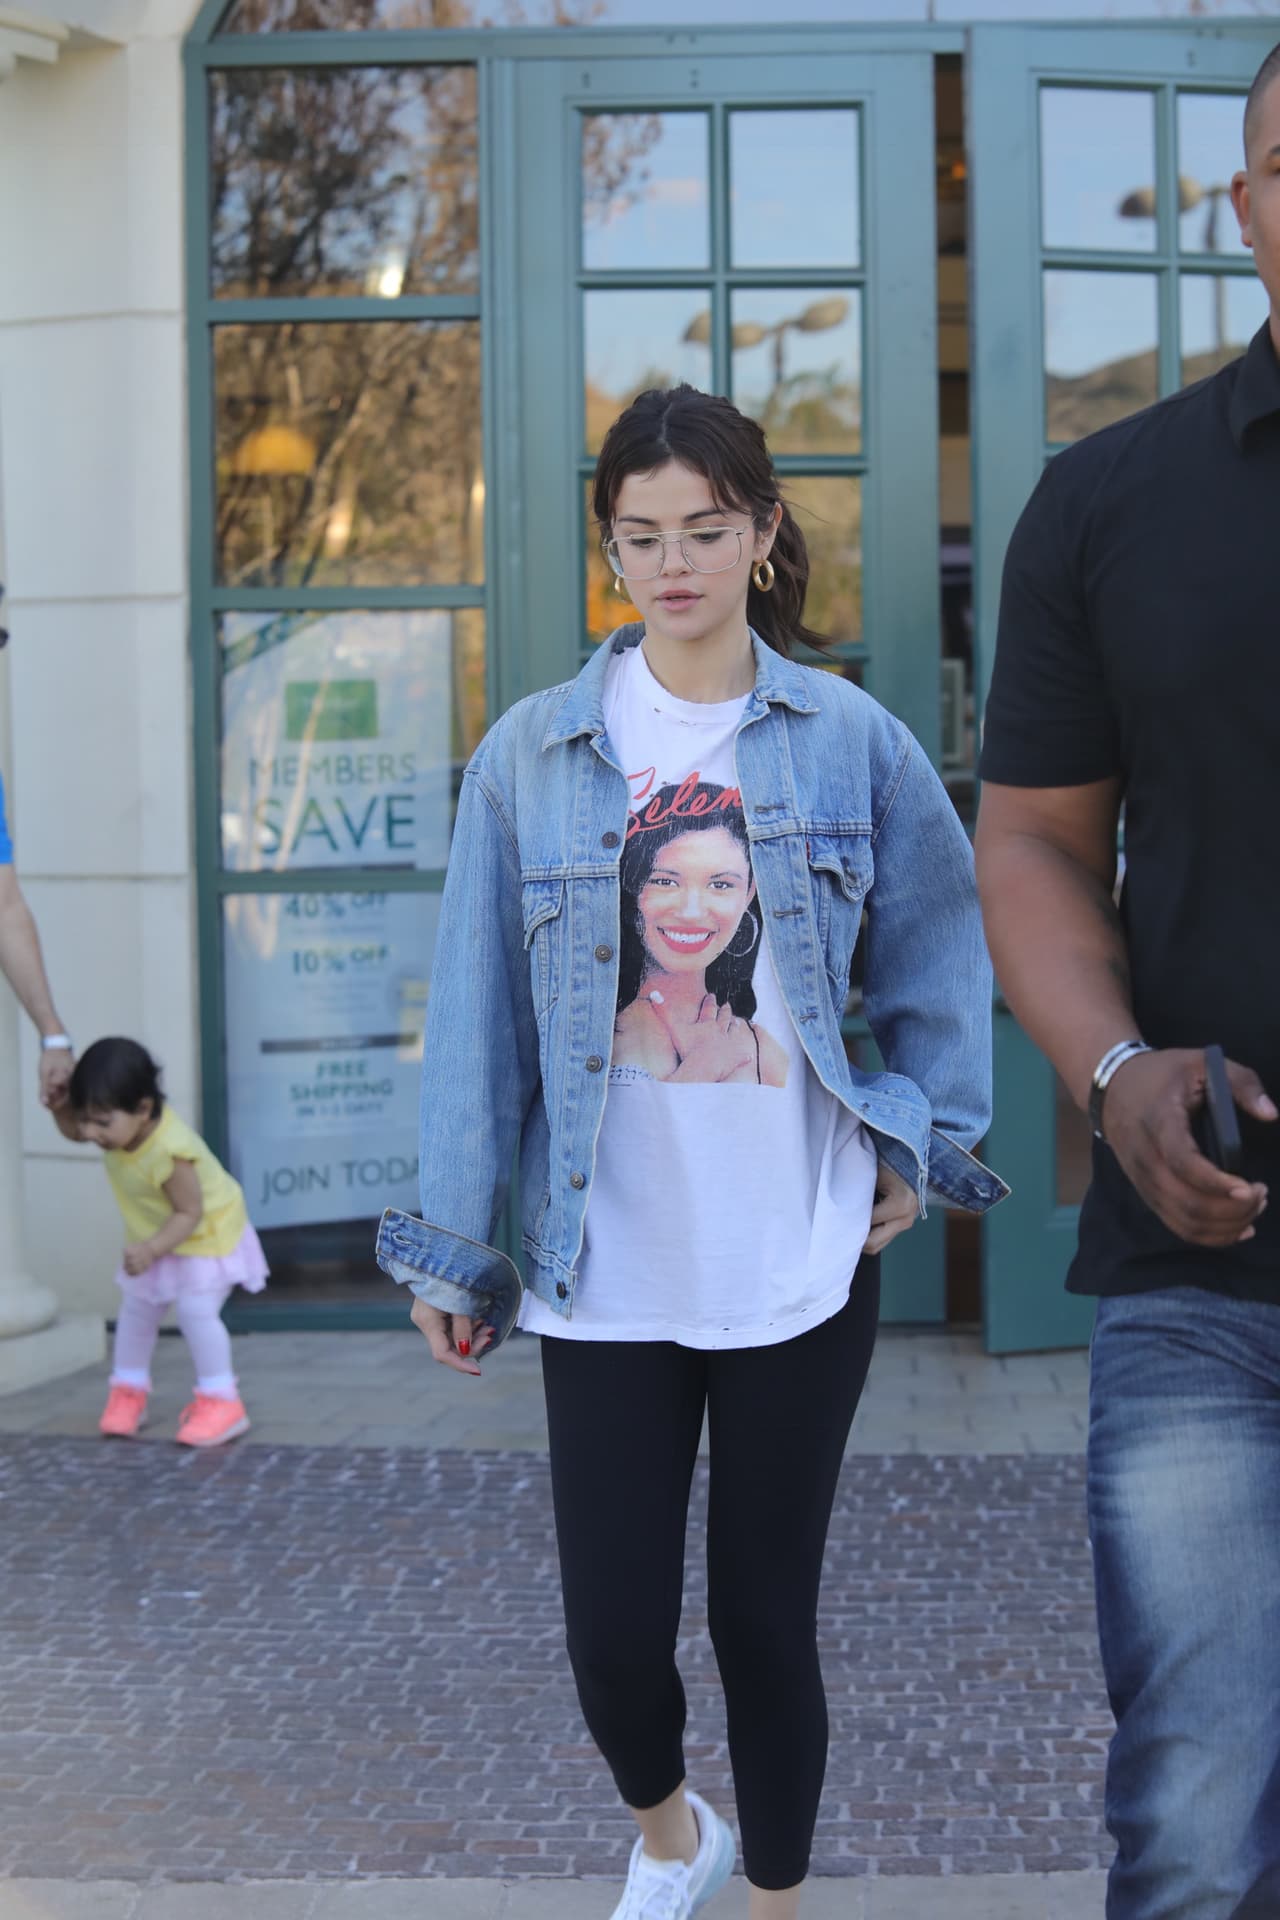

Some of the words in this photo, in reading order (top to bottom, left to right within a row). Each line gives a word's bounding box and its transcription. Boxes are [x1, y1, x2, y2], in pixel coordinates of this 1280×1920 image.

[249, 754, 417, 787] MEMBERS
[625, 766, 743, 840] Selen
[256, 795, 415, 854] SAVE
[292, 949, 346, 974] 10%
[315, 1058, 369, 1078] FREE
[290, 1079, 394, 1101] SHIPPING
[260, 1164, 330, 1205] JOIN
[341, 1155, 420, 1188] TODA
